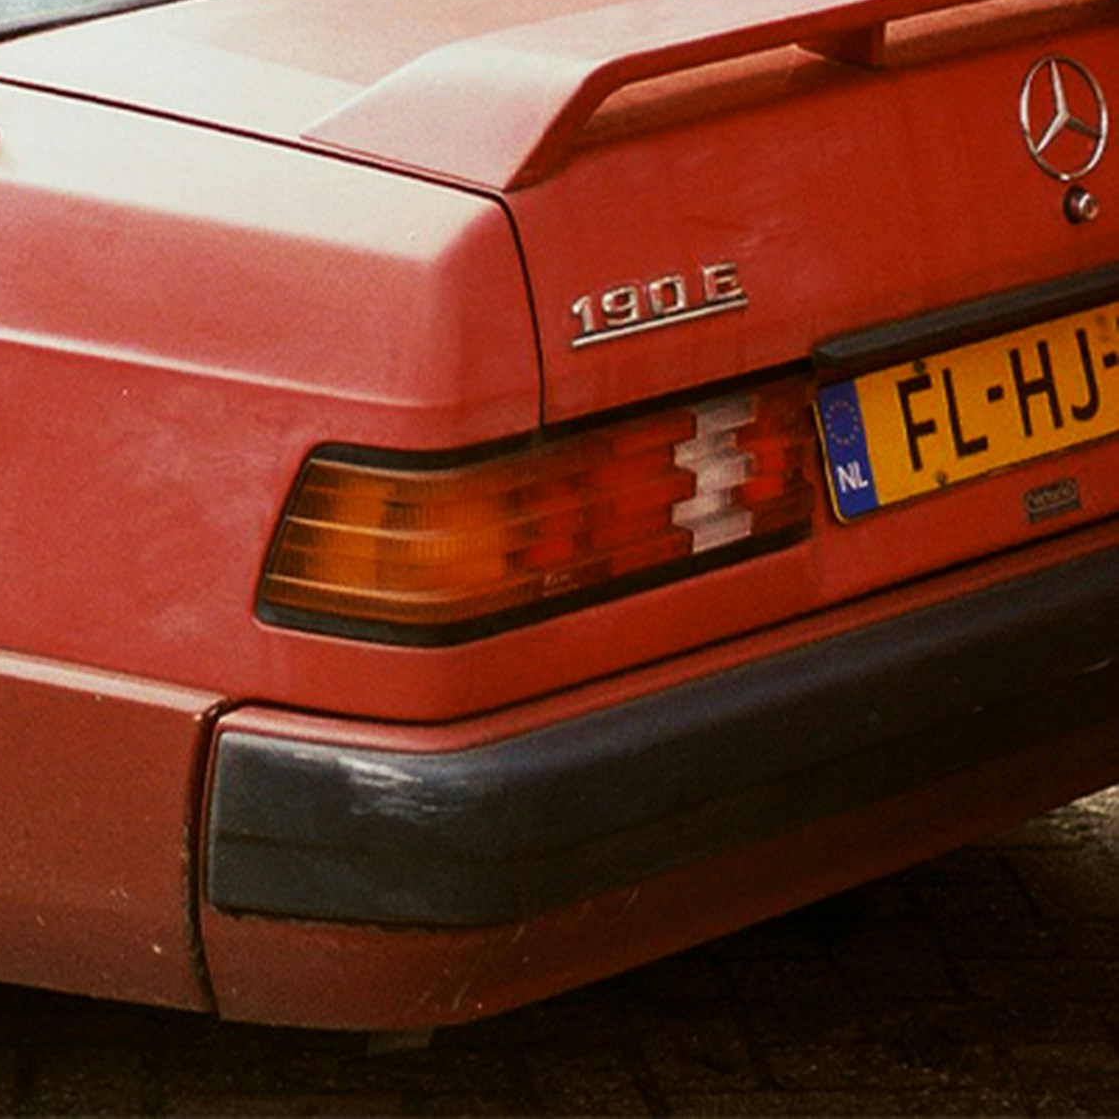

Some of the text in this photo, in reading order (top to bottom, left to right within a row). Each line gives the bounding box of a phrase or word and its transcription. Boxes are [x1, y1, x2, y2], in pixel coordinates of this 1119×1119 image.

[571, 261, 746, 335] 190 E
[896, 314, 1119, 472] FL-HJ-
[836, 460, 869, 493] NL
